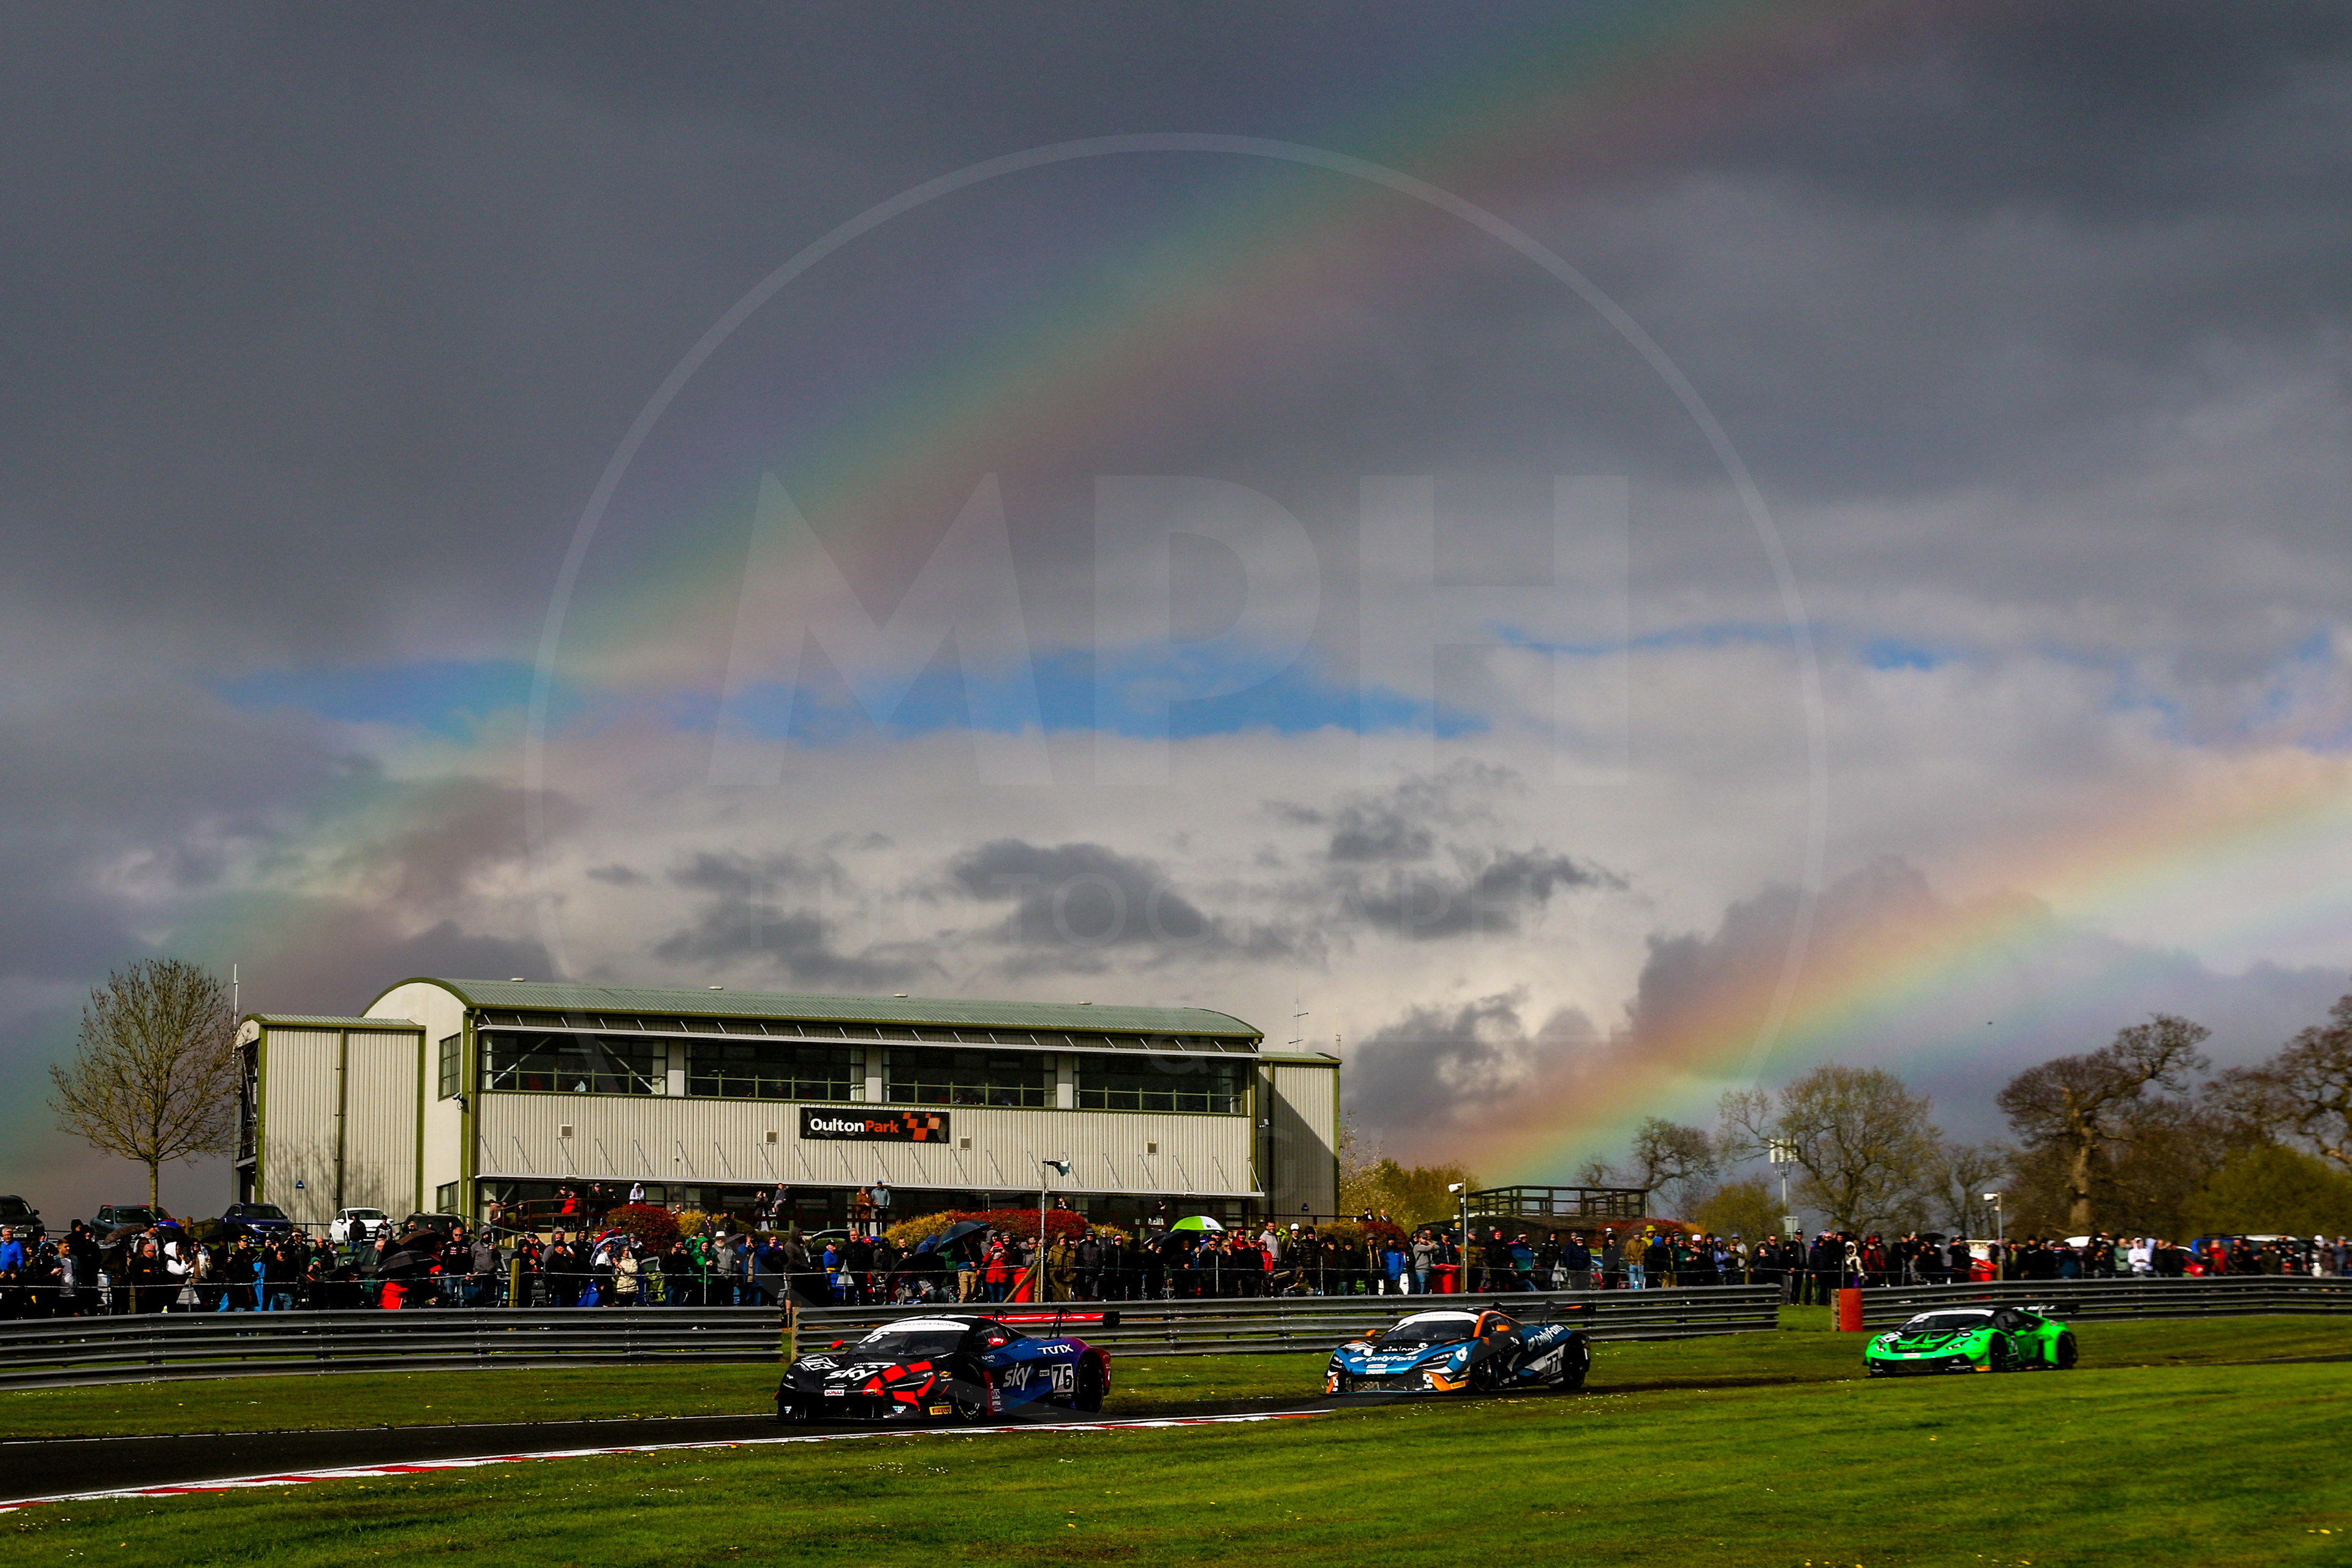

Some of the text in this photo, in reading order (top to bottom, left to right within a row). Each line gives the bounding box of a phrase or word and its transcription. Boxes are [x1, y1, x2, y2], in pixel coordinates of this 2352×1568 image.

[1534, 1324, 1565, 1346] OnlyFans
[824, 1367, 878, 1381] sky
[1547, 1353, 1559, 1374] 77
[1003, 1362, 1032, 1391] sky
[1053, 1365, 1072, 1390] 76
